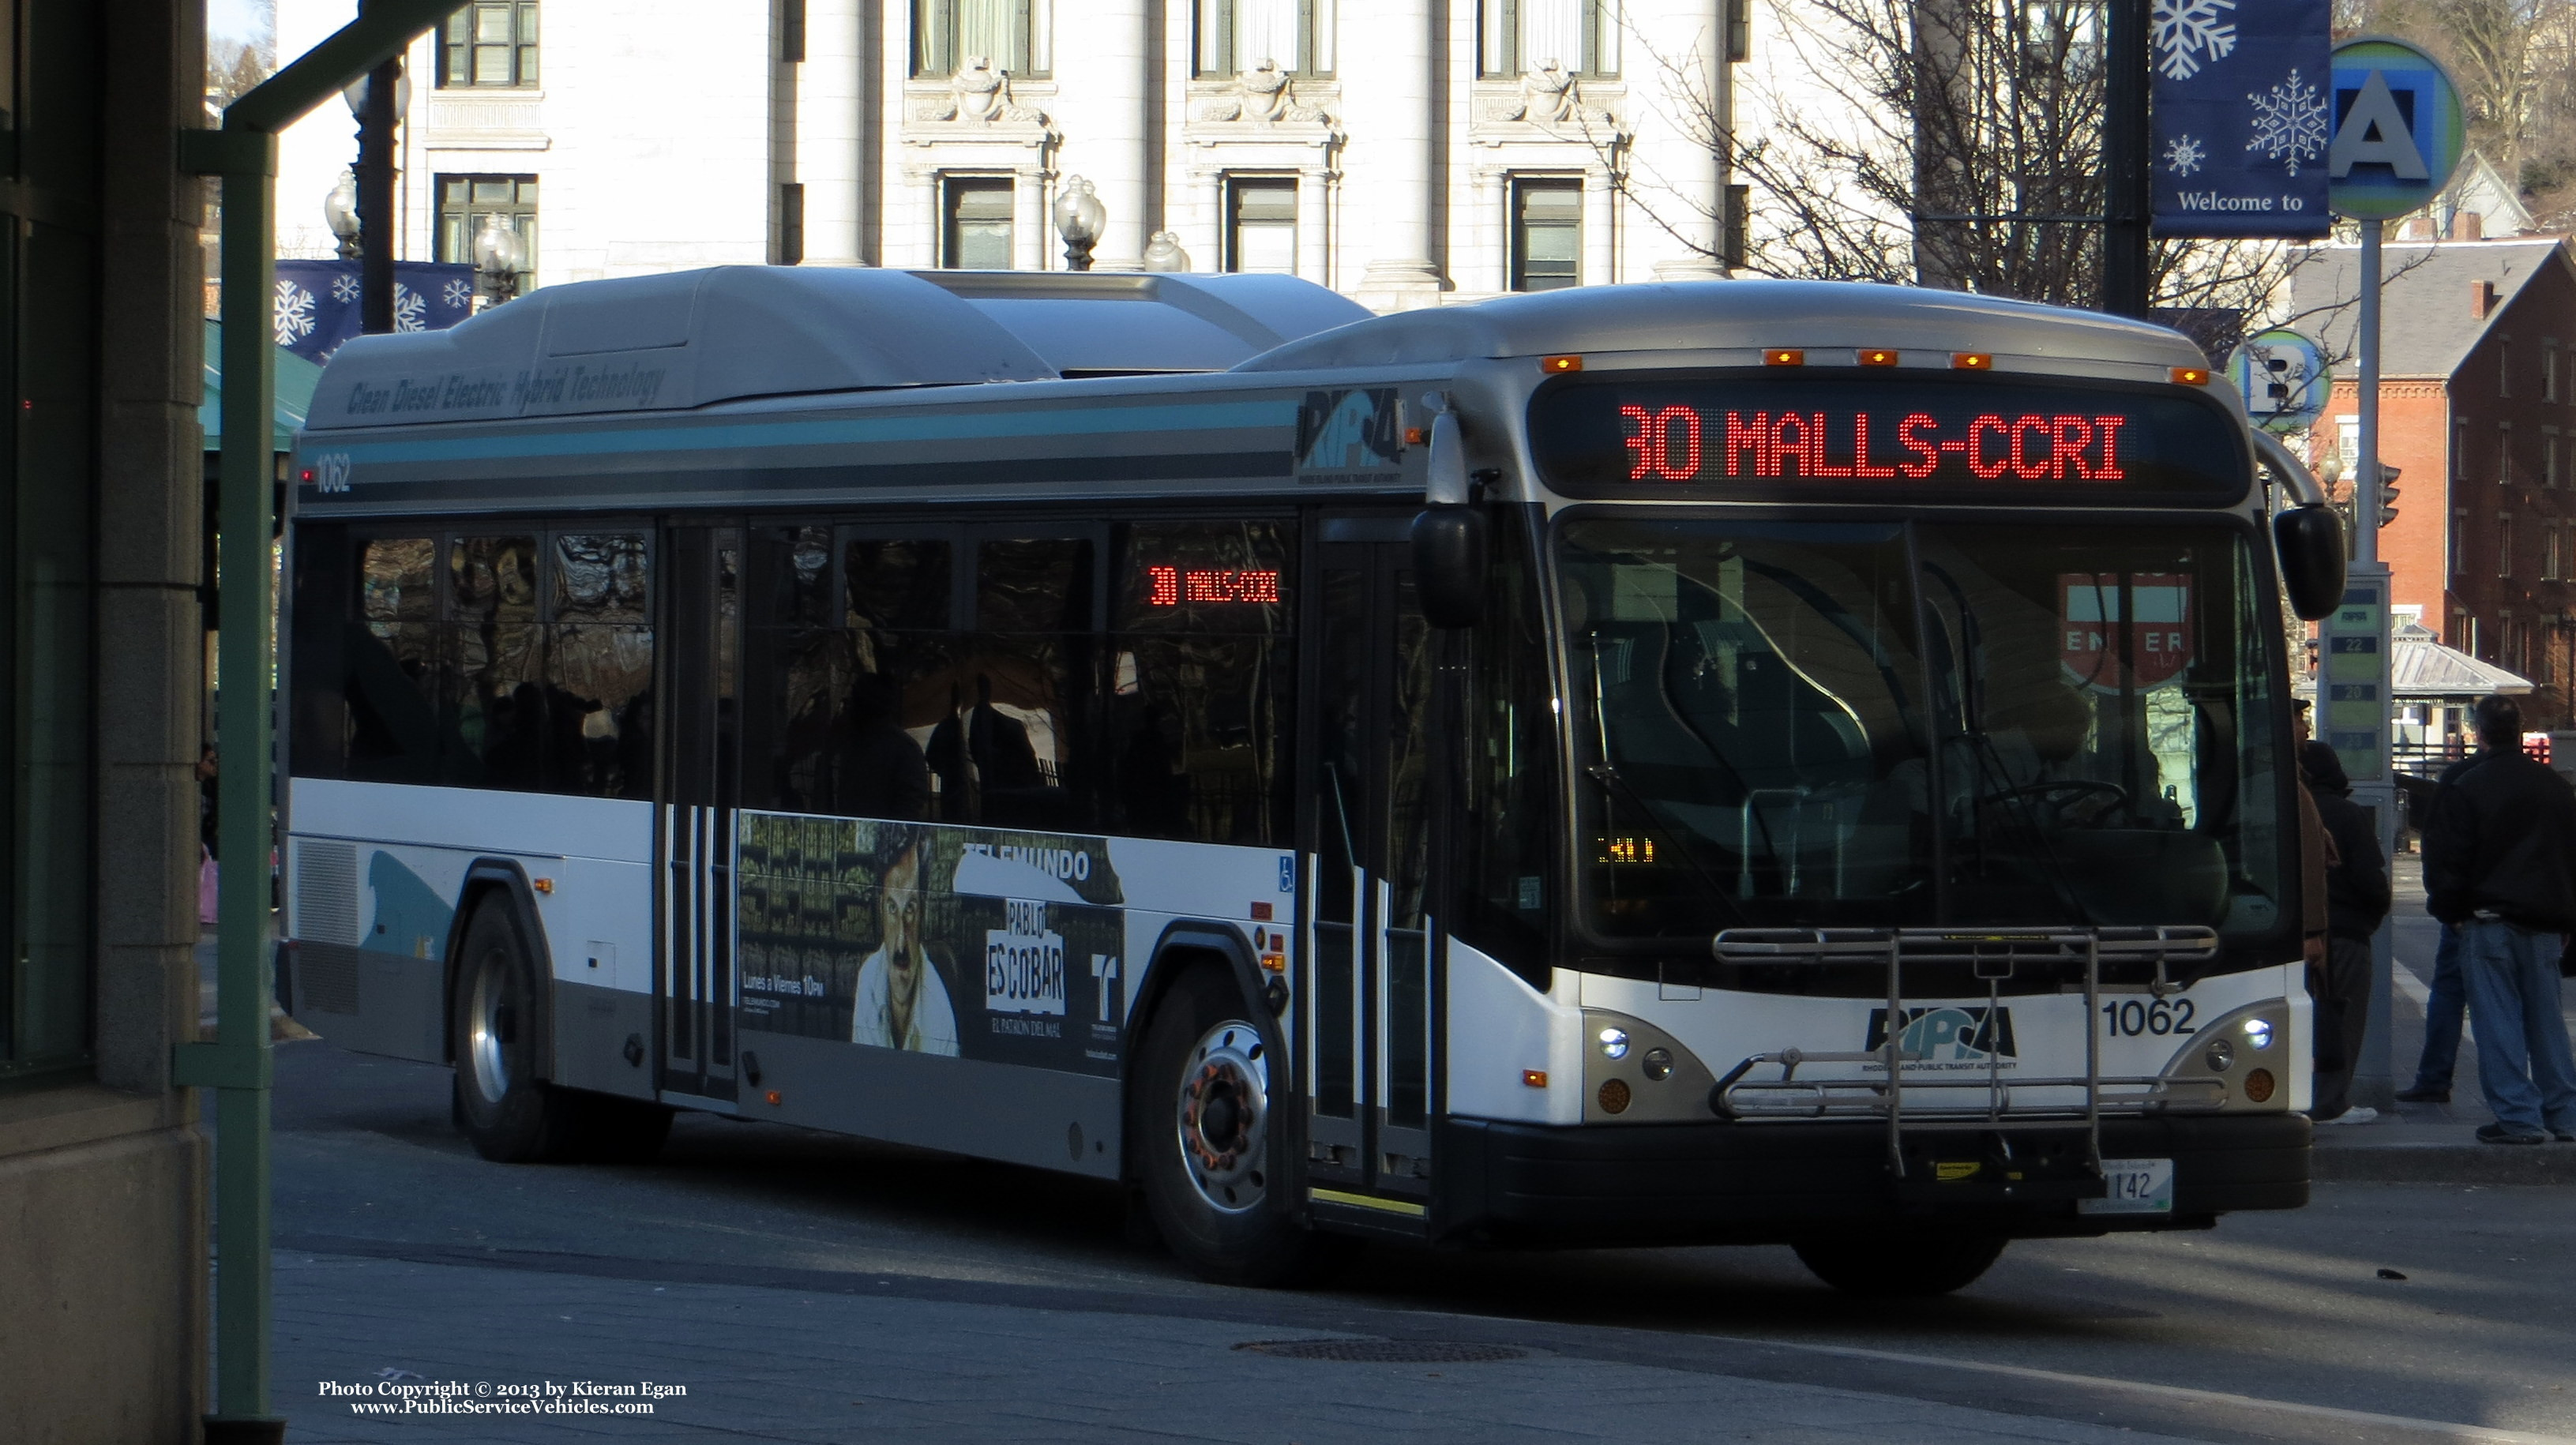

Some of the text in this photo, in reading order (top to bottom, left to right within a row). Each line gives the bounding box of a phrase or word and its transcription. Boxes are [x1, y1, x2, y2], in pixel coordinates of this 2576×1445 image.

[2329, 69, 2430, 179] A
[2177, 191, 2303, 211] Welcome to
[347, 362, 667, 415] Clean Diesel Electric Hybrid Technology
[2250, 344, 2308, 412] B
[1620, 406, 2125, 480] 30 MALLS-CCRI
[316, 453, 351, 494] 1062
[1150, 566, 1279, 605] 30 MALLS-CCRI
[2067, 631, 2184, 651] ENER
[2345, 638, 2362, 651] 22
[2345, 685, 2362, 699] 20
[1008, 902, 1045, 939] PABLO
[744, 971, 766, 990] Lunes
[768, 978, 772, 991] a
[774, 974, 801, 995] Viernes
[989, 943, 1062, 1000] ESCOBAR
[992, 1017, 999, 1033] EL
[1031, 1020, 1045, 1036] DEL
[1046, 1023, 1062, 1038] MAL
[2103, 998, 2195, 1036] 1062
